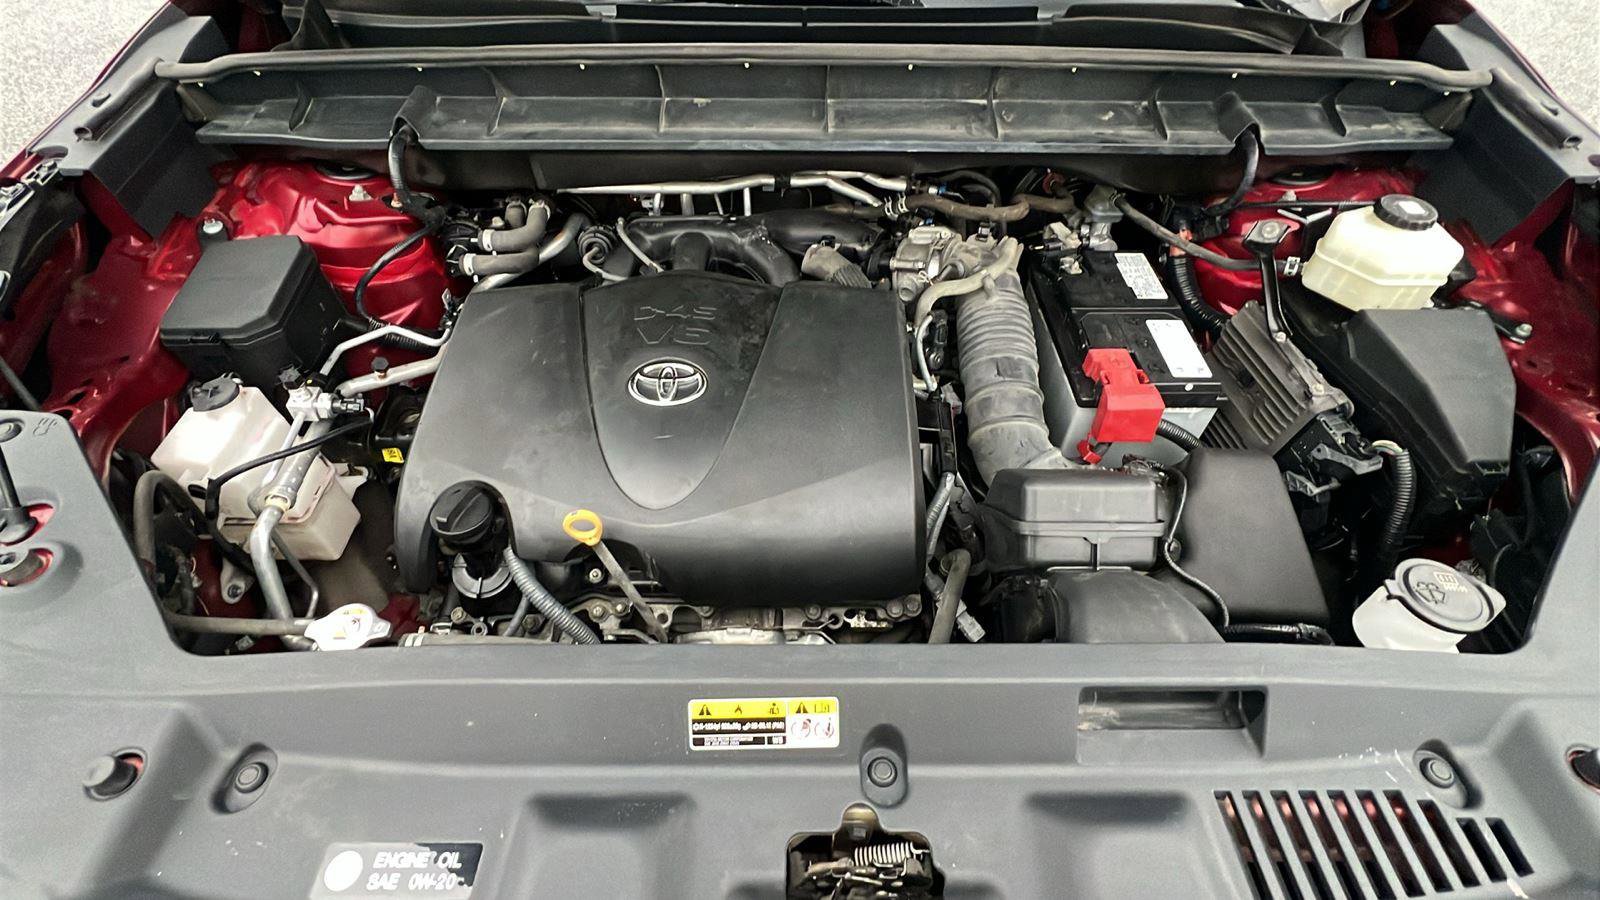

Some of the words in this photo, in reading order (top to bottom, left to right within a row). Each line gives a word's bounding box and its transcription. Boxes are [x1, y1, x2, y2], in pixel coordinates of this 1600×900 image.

[636, 325, 711, 345] V6
[372, 851, 431, 869] ENGINE
[437, 851, 463, 869] OIL
[366, 872, 400, 891] SAE
[408, 872, 455, 891] 0W-20
